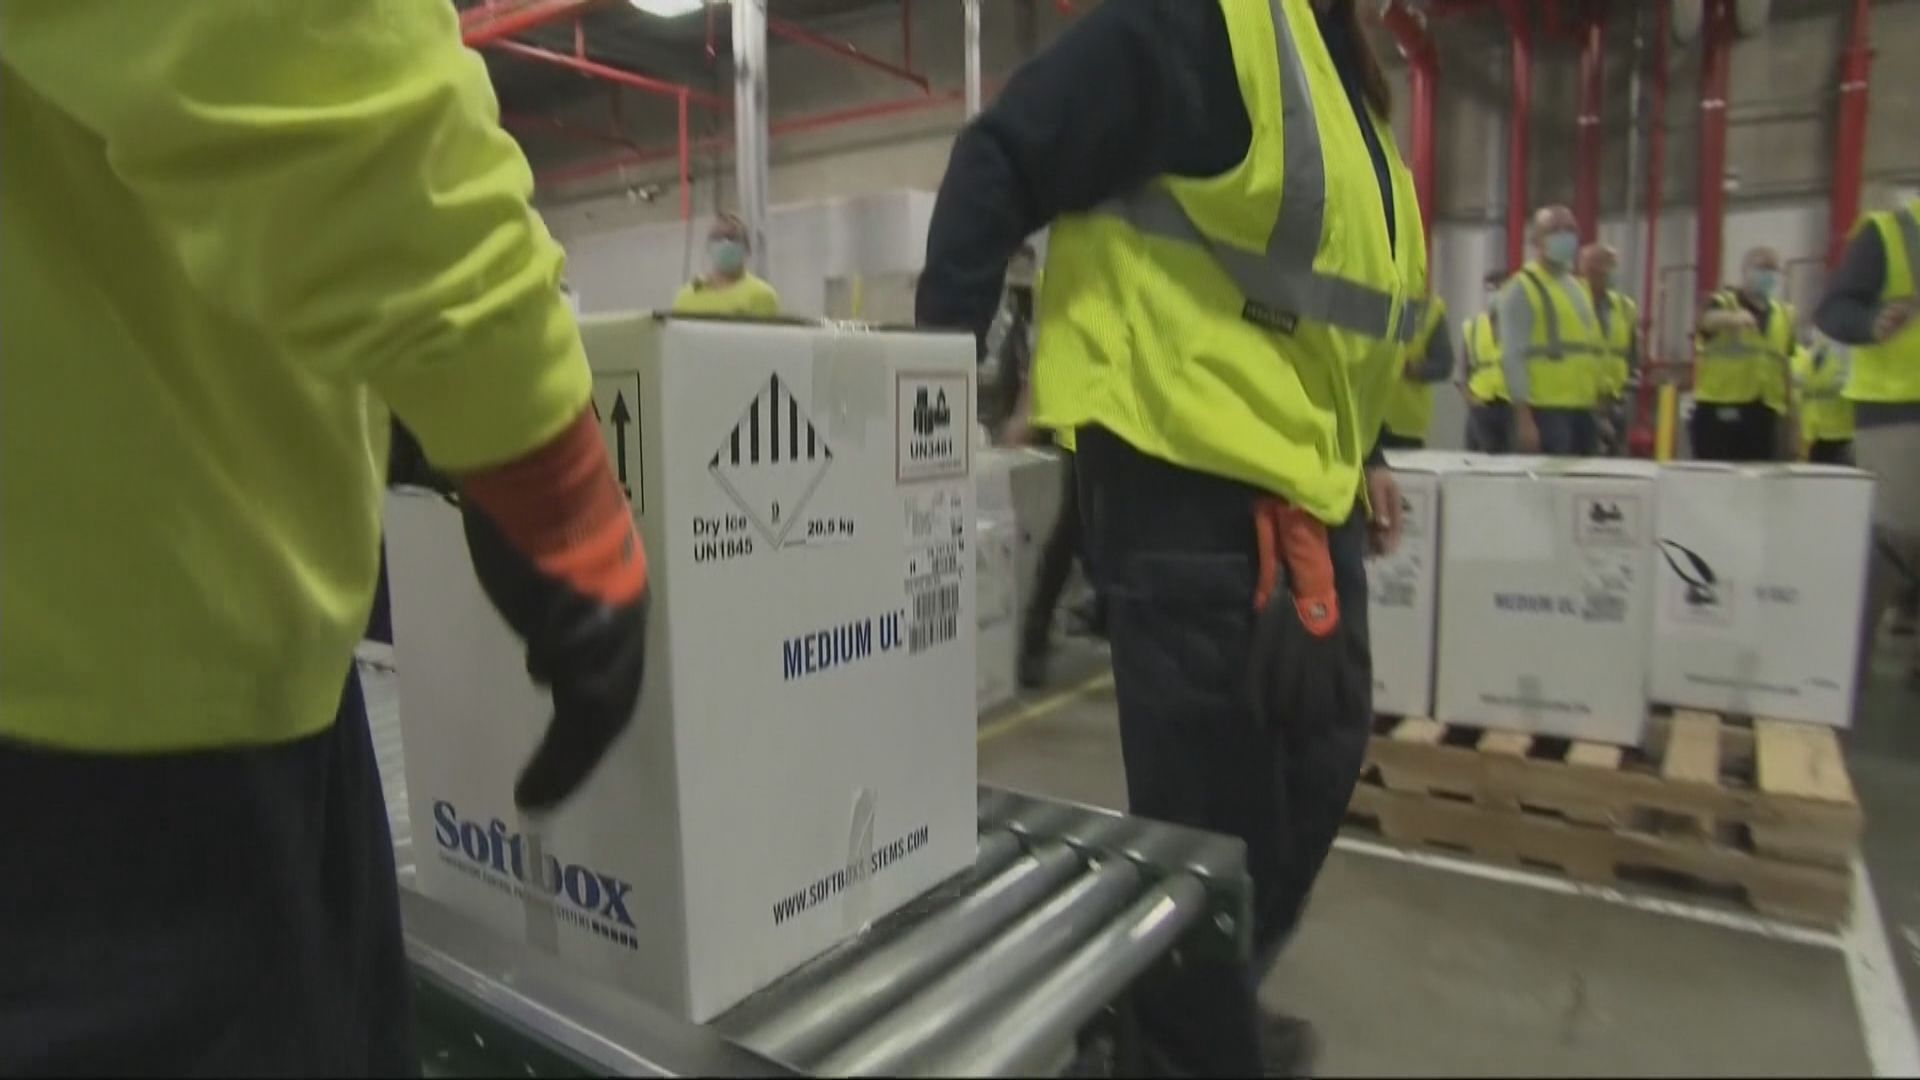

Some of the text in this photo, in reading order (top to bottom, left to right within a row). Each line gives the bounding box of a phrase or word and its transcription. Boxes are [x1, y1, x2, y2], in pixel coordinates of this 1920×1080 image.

[693, 513, 747, 537] Dry Ice
[694, 535, 753, 563] UN1845
[807, 516, 854, 537] 20.5 kg
[783, 607, 905, 681] MEDIUM UL
[434, 800, 637, 930] Softbox
[773, 824, 929, 926] WWW.SOFTBOXSSTEMS.COM
